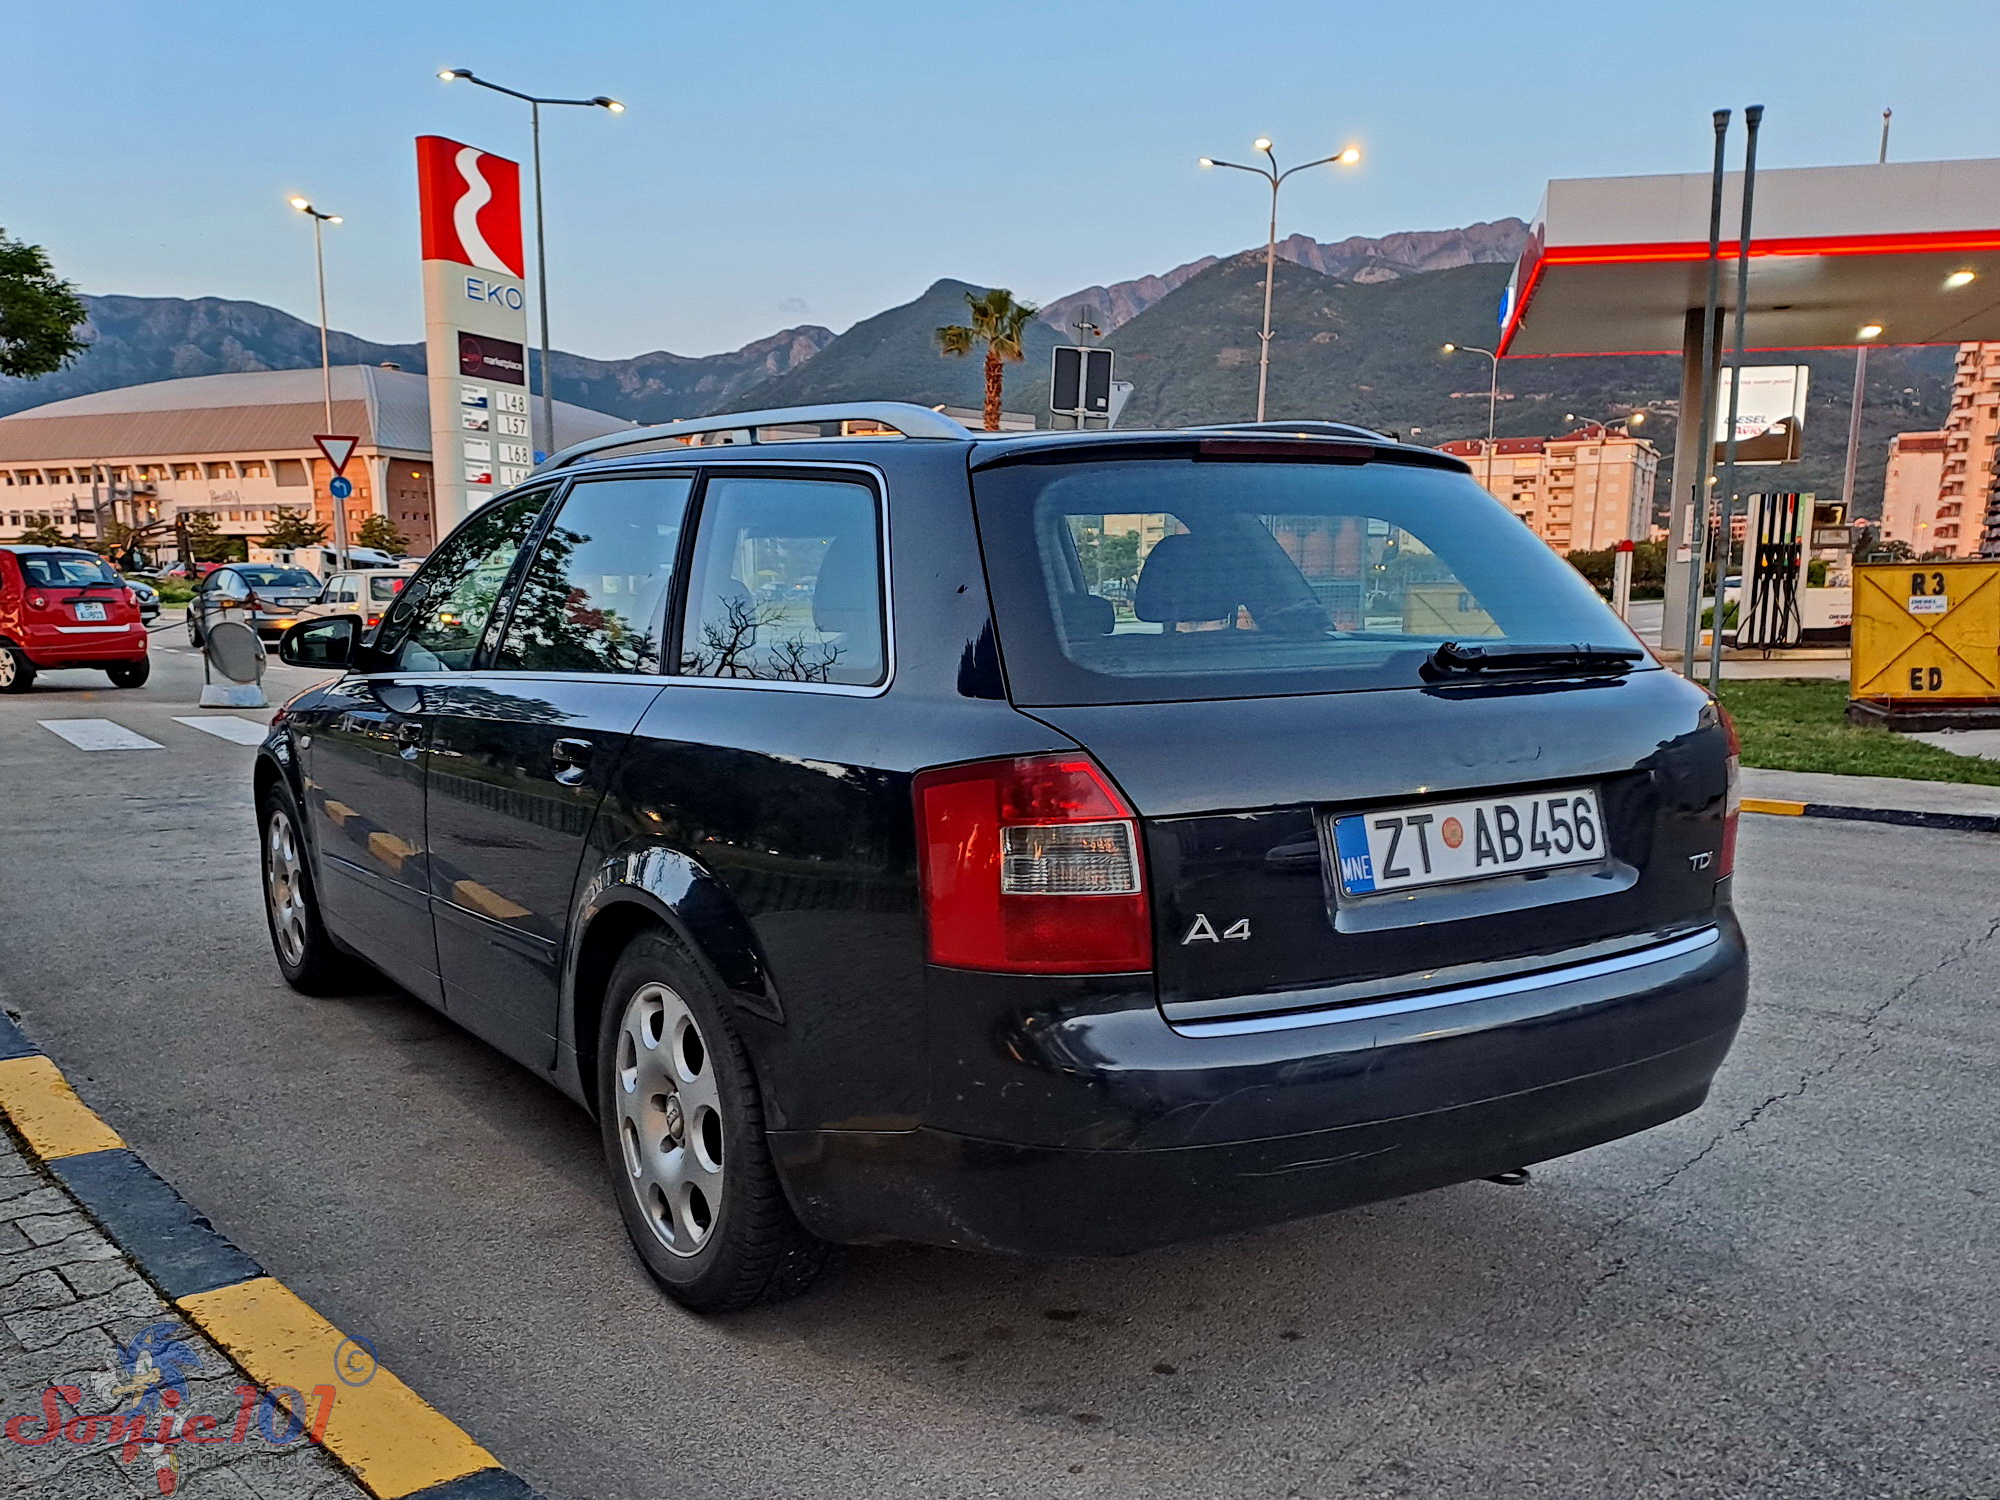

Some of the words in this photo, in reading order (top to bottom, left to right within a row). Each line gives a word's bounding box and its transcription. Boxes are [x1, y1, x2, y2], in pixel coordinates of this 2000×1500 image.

[464, 276, 523, 311] EKO
[483, 356, 523, 371] marketplace
[1374, 813, 1434, 880] ZT
[1475, 796, 1596, 867] AB456
[1341, 854, 1372, 882] MNE
[1181, 913, 1252, 946] A4
